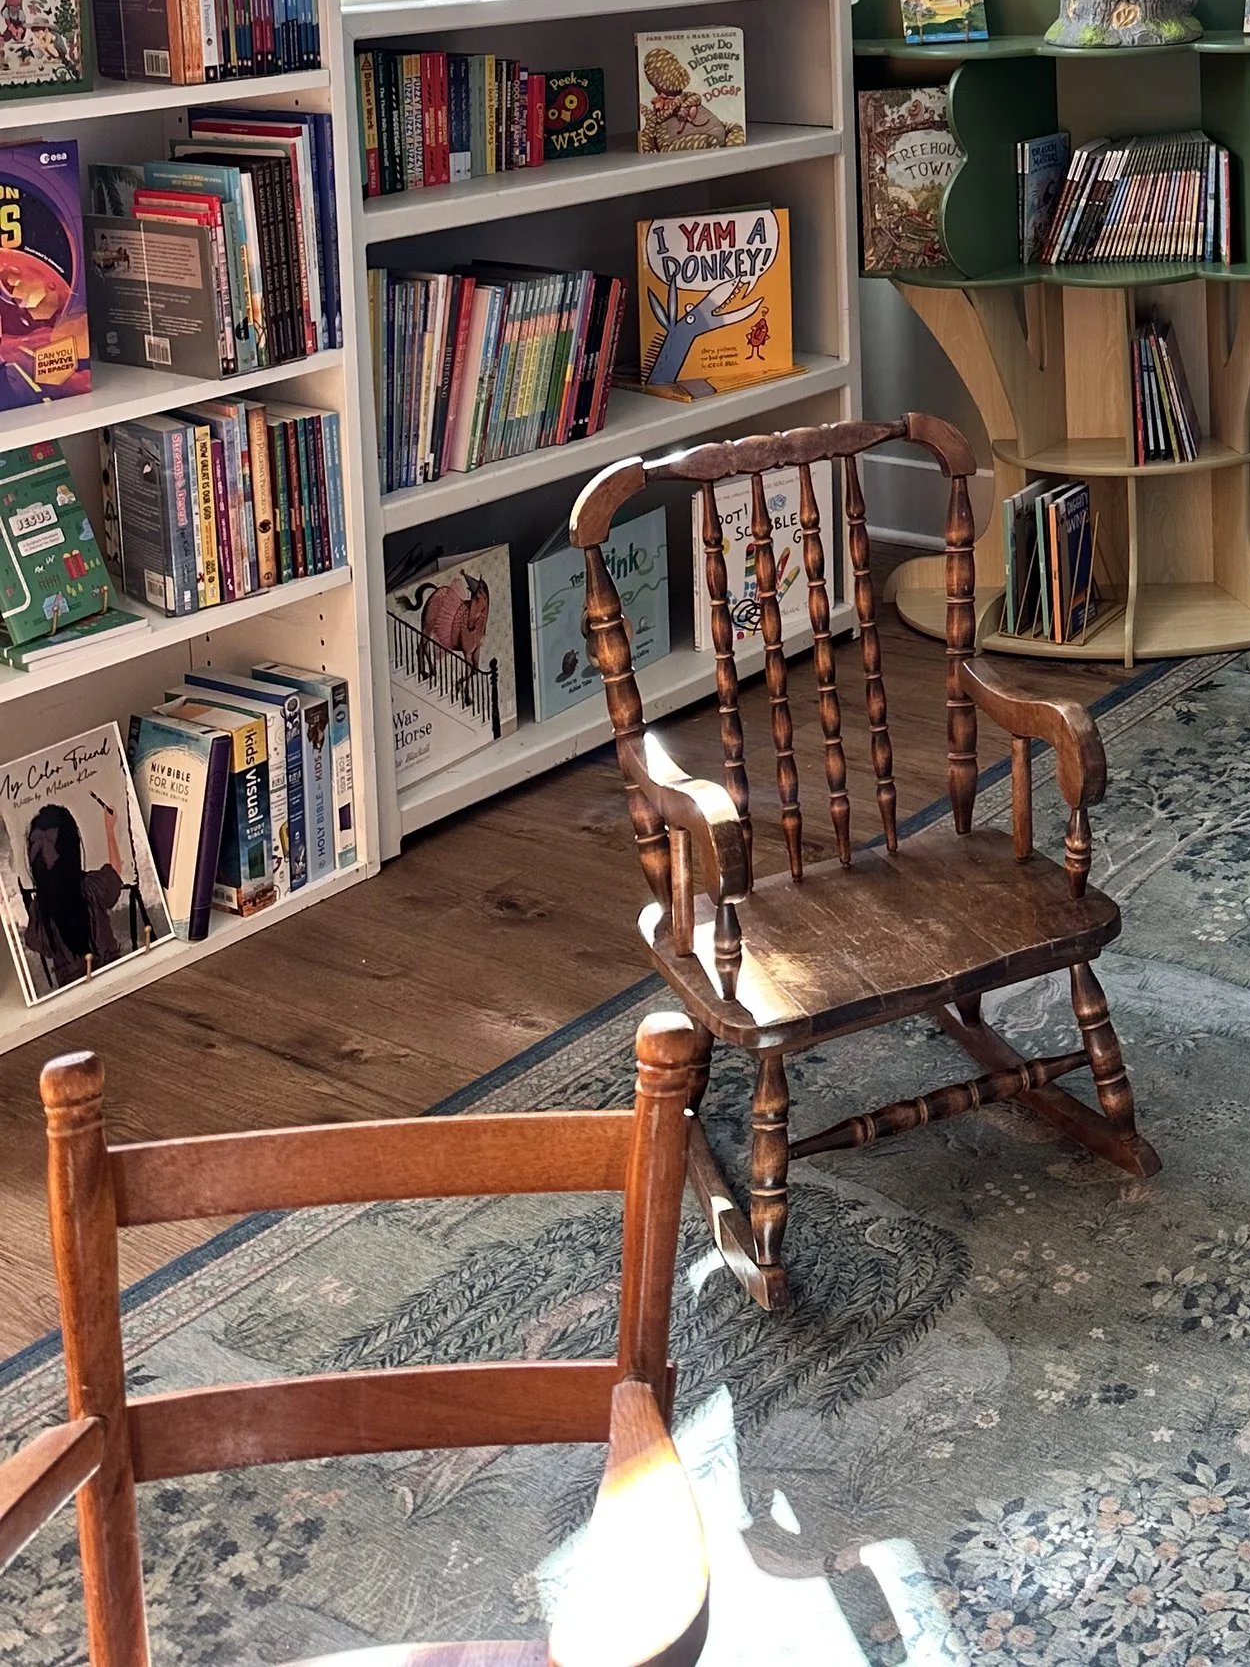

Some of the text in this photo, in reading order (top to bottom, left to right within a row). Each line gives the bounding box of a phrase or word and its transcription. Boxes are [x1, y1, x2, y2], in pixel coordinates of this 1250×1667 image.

[691, 39, 733, 56] How Do
[687, 52, 740, 71] Dinosaurs
[703, 64, 730, 75] Love
[550, 72, 588, 91] Peek-a
[704, 73, 734, 88] Their
[703, 86, 741, 103] DOGS?
[551, 110, 605, 151] WHO?
[653, 217, 767, 255] I YAM A
[662, 248, 772, 283] DONKEY!
[37, 349, 72, 361] CAN YOU
[37, 356, 73, 369] SURVIVE
[48, 363, 74, 373] SPACE?
[17, 510, 51, 531] JESUS
[392, 708, 419, 729] Was
[394, 722, 432, 751] Horse
[27, 761, 63, 790] Color
[63, 738, 111, 771] Friend
[151, 762, 191, 783] NIV BIBLE
[150, 774, 167, 788] FOR
[170, 779, 189, 797] KIDS
[244, 735, 262, 824] kids visual
[314, 757, 324, 857] HOLY BIBLE KIDS
